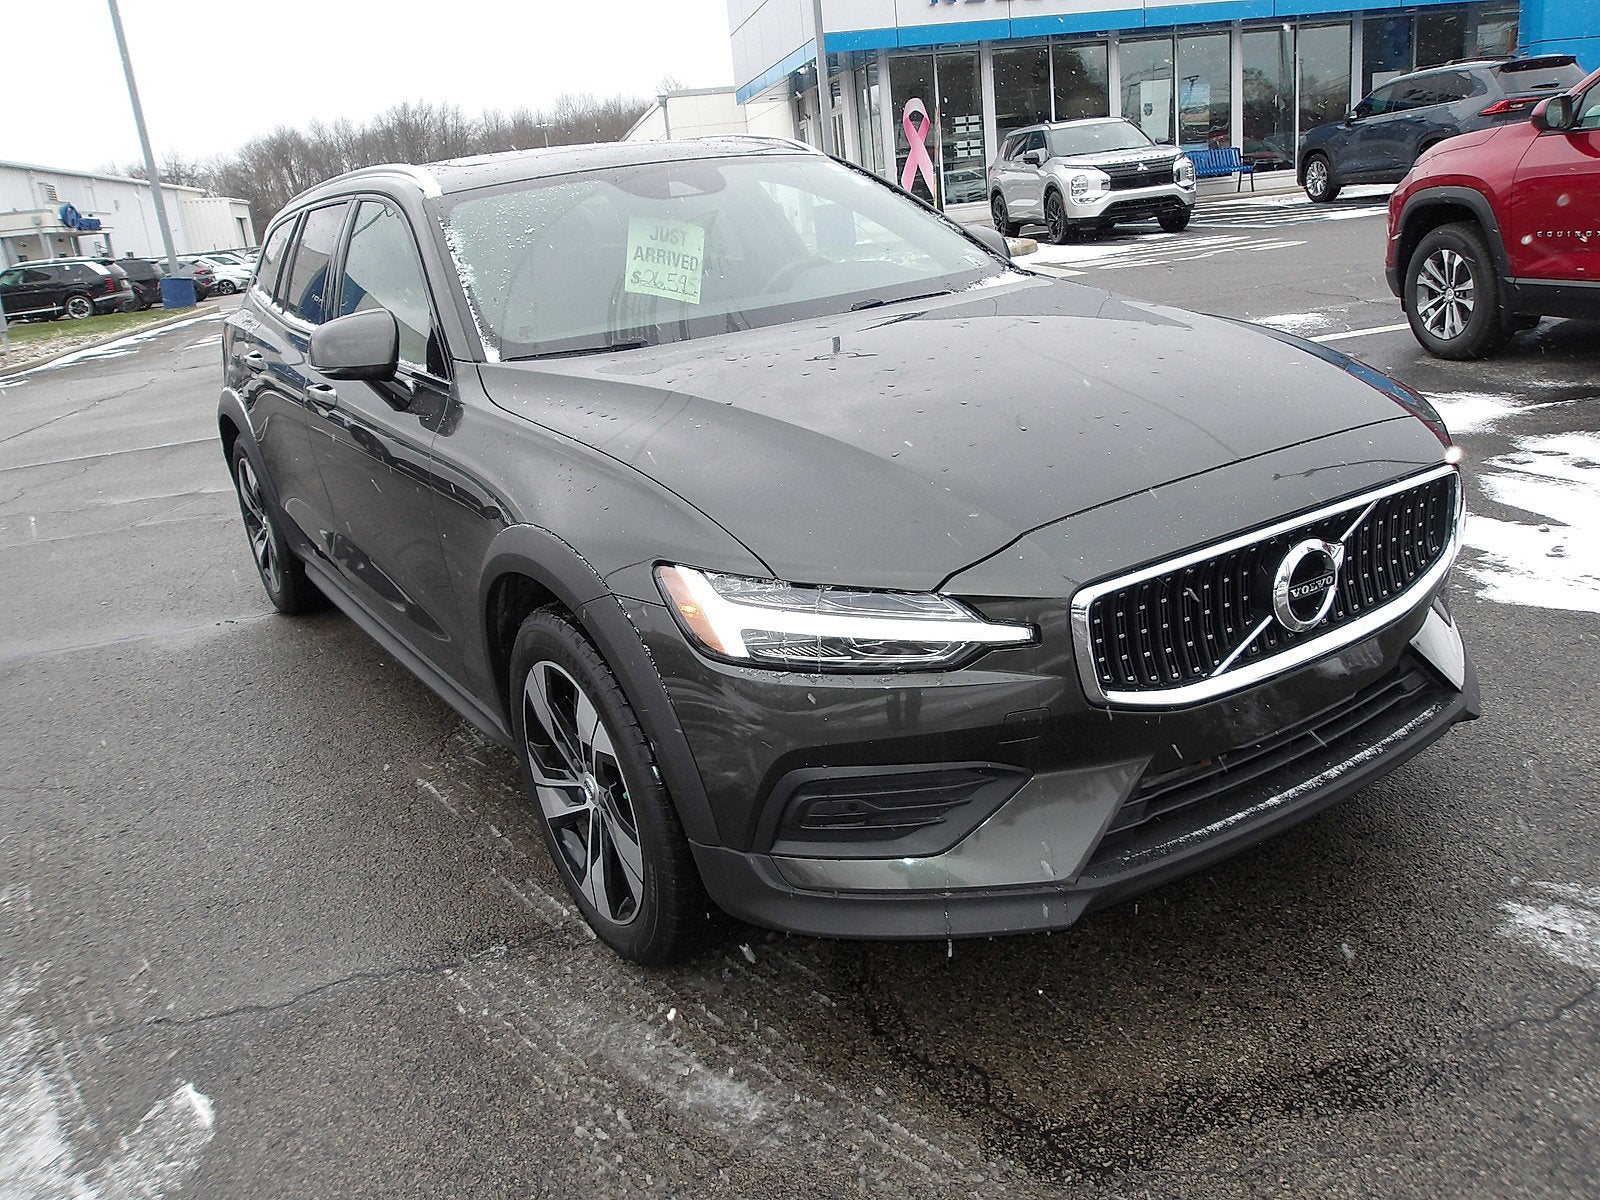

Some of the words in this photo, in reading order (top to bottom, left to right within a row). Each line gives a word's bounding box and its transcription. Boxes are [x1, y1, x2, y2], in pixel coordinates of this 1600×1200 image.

[649, 224, 688, 247] JUST
[632, 245, 699, 271] ARRIVED
[1290, 575, 1334, 598] VOLVO
